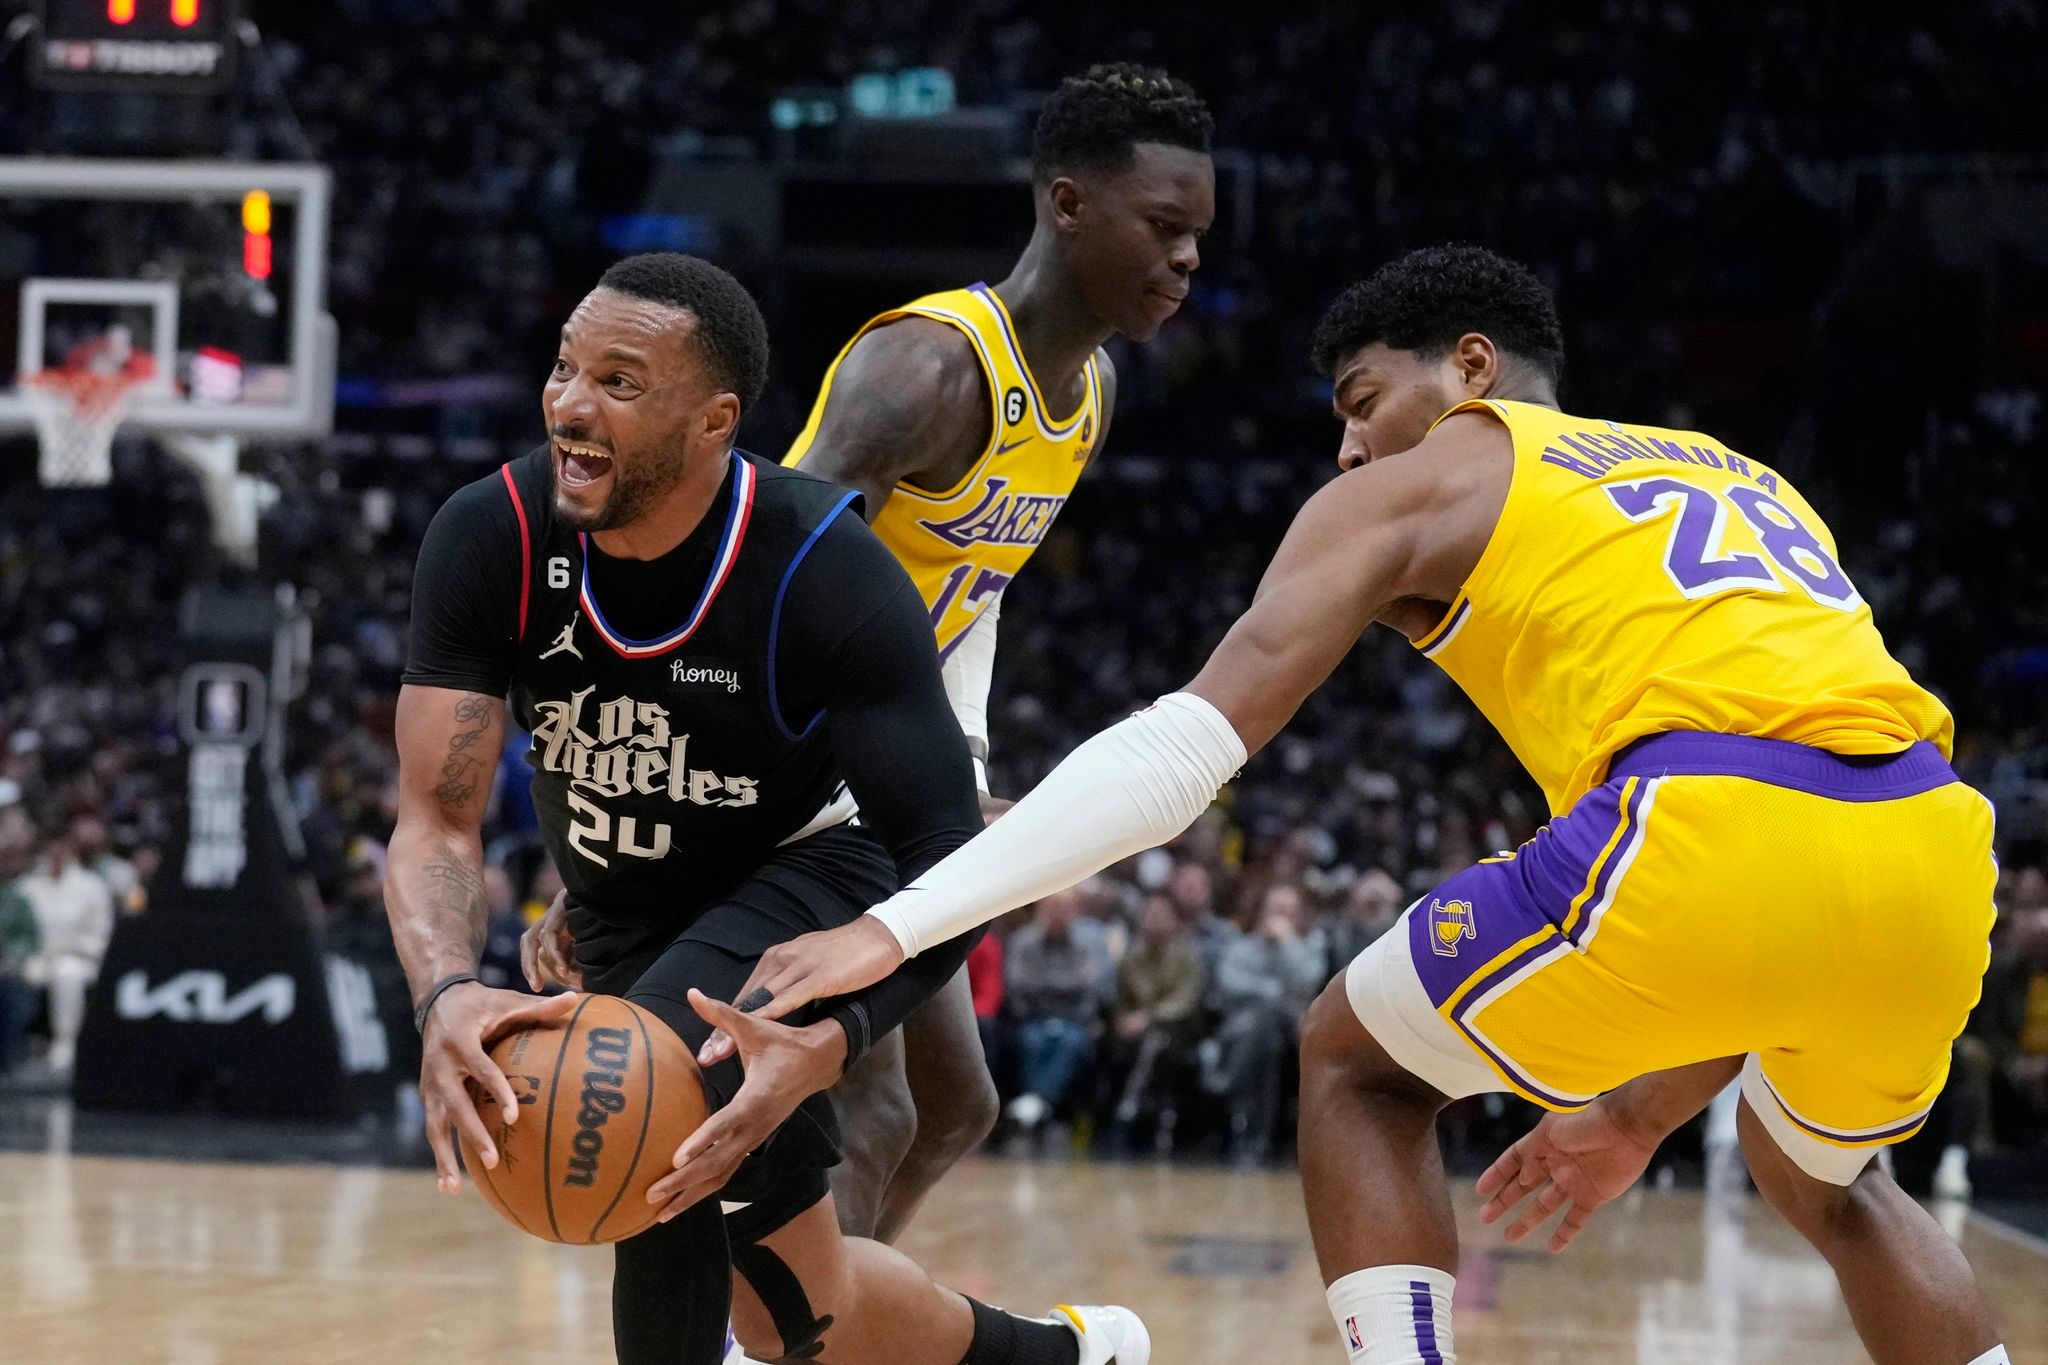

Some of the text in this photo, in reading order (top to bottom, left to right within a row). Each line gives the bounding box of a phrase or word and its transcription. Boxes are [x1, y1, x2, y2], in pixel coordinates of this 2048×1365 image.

[1007, 392, 1022, 422] 6
[1540, 432, 1779, 495] HACHIMURA
[548, 556, 570, 589] 6
[1600, 474, 1865, 613] 28
[669, 658, 741, 693] honey
[568, 683, 671, 750] Los
[530, 700, 760, 808] Angeles
[566, 790, 672, 869] 24
[563, 1025, 633, 1188] Wilson
